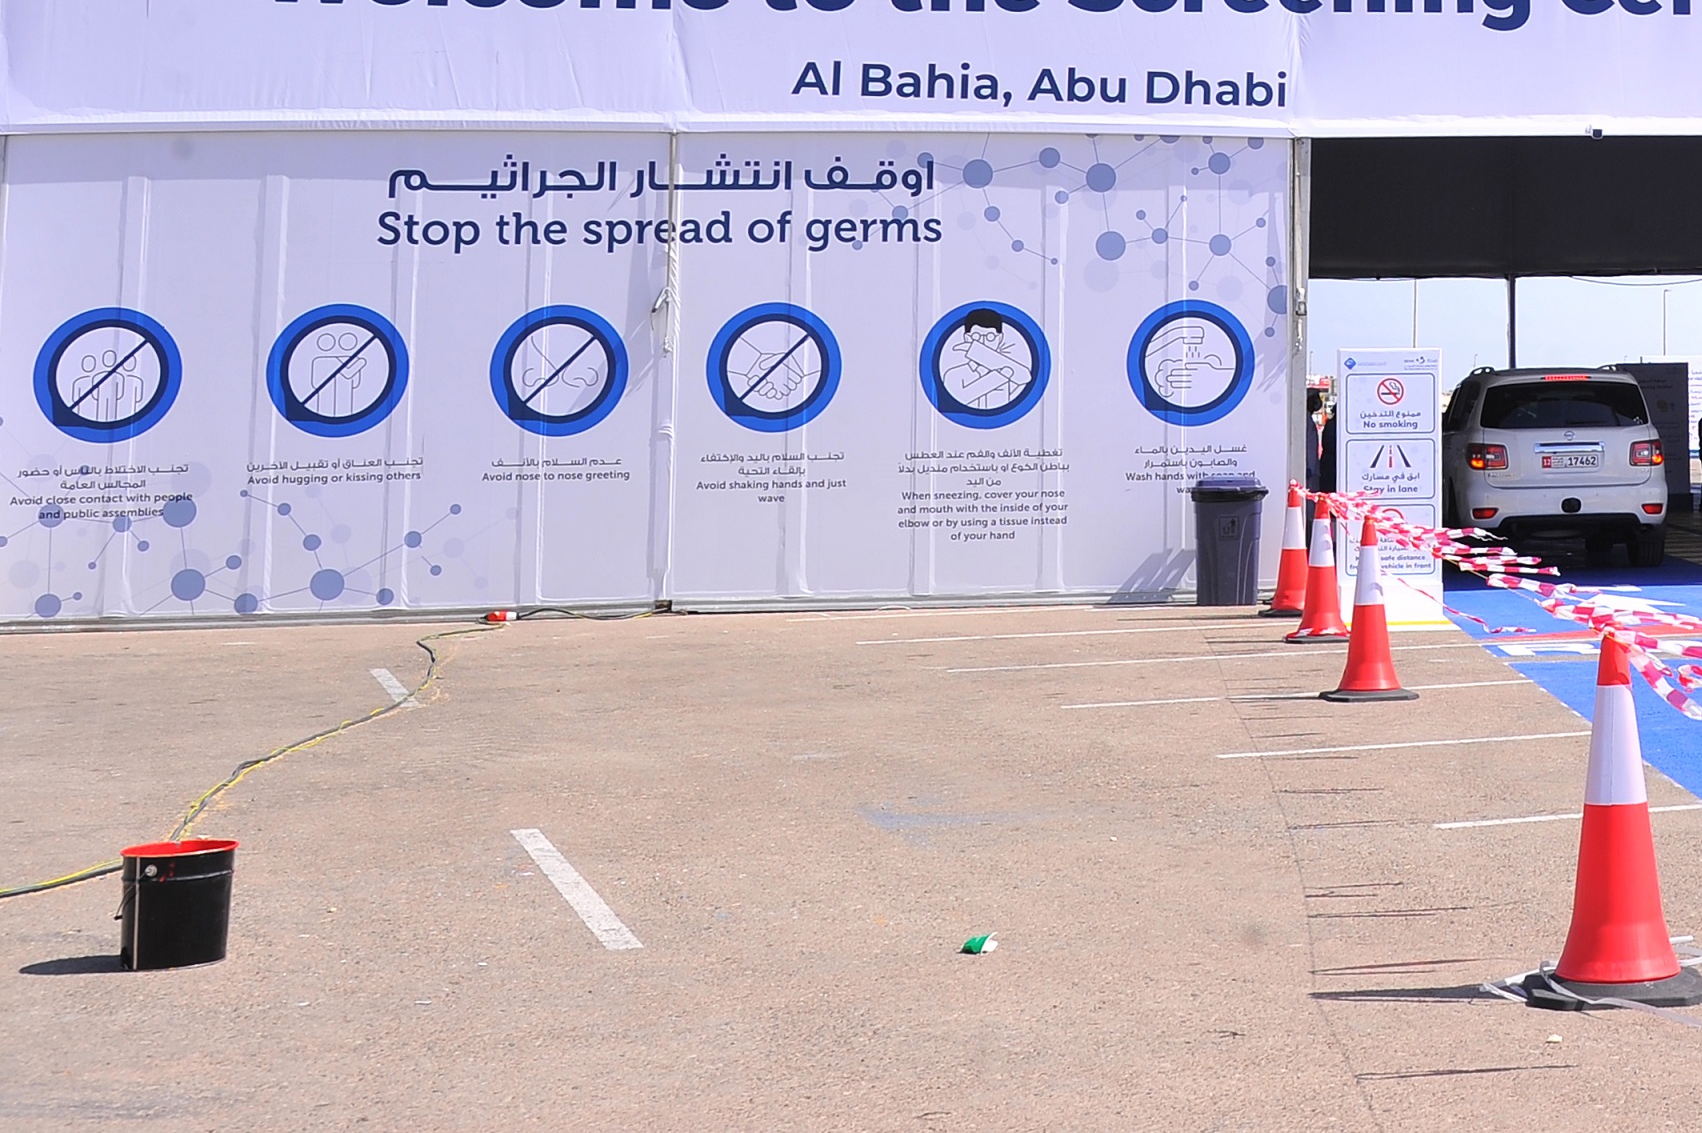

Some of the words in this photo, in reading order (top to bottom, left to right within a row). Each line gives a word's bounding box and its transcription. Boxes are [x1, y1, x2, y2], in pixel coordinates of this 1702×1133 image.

[792, 61, 841, 97] Al
[860, 63, 1014, 107] Bahia,
[1028, 67, 1127, 104] Abu
[1146, 70, 1287, 109] Dhabi
[388, 154, 616, 199] الجراثيم
[630, 153, 792, 198] انتشار
[377, 210, 481, 254] Stop
[496, 212, 568, 246] the
[582, 211, 732, 253] spread
[747, 210, 792, 244] of
[805, 216, 942, 252] germs
[1360, 410, 1394, 419] التدخين
[1396, 410, 1421, 418] ممنوع
[1379, 420, 1418, 429] smoking
[946, 450, 964, 459] عند
[1024, 448, 1063, 459] تغطية
[1135, 446, 1168, 455] بالماء
[1171, 445, 1212, 455] اليدين
[1214, 445, 1247, 454] غسل
[747, 454, 769, 463] باليد
[772, 453, 805, 463] السلام
[807, 452, 844, 461] تجنب
[905, 451, 943, 460] العطس
[384, 457, 423, 467] تجنب
[542, 458, 587, 468] السلام
[589, 458, 621, 467] عدم
[1568, 457, 1596, 466] 17462
[17, 467, 49, 478] حضور
[148, 464, 188, 475] تجنب
[738, 467, 770, 477] التحية
[248, 475, 279, 484] Avoid
[282, 474, 328, 485] hugging
[331, 474, 343, 482] or
[346, 472, 383, 484] kissing
[386, 472, 421, 480] others
[482, 472, 512, 481] Avoid
[516, 473, 540, 481] nose
[586, 470, 630, 481] greeting
[1125, 472, 1152, 481] Wash
[1155, 472, 1184, 481] hands
[1362, 473, 1390, 482] مسارك
[1392, 472, 1405, 483] في
[60, 481, 95, 491] العامة
[696, 481, 726, 490] Avoid
[729, 480, 768, 491] shaking
[772, 481, 802, 489] hands
[805, 479, 824, 488] and
[827, 479, 847, 489] just
[10, 496, 42, 506] Avoid
[46, 496, 76, 505] close
[79, 495, 122, 504] contact
[126, 494, 151, 502] with
[154, 492, 193, 503] people
[758, 495, 785, 503] wave
[902, 491, 930, 500] When
[934, 491, 981, 501] sneezing,
[984, 491, 1012, 499] cover
[1015, 491, 1038, 500] your
[1041, 490, 1065, 498] nose
[38, 510, 60, 520] and
[64, 508, 99, 520] public
[102, 507, 164, 518] assemblies
[898, 505, 916, 514] and
[920, 505, 953, 514] mouth
[956, 504, 978, 513] with
[981, 504, 997, 513] the
[1000, 503, 1029, 512] inside
[1032, 503, 1042, 512] of
[1045, 503, 1068, 513] your
[898, 519, 929, 528] elbow
[946, 518, 957, 528] by
[960, 518, 988, 528] using
[999, 517, 1028, 526] tissue
[1031, 516, 1067, 525] instead
[951, 532, 961, 540] of
[963, 533, 987, 542] your
[990, 531, 1015, 540] hand
